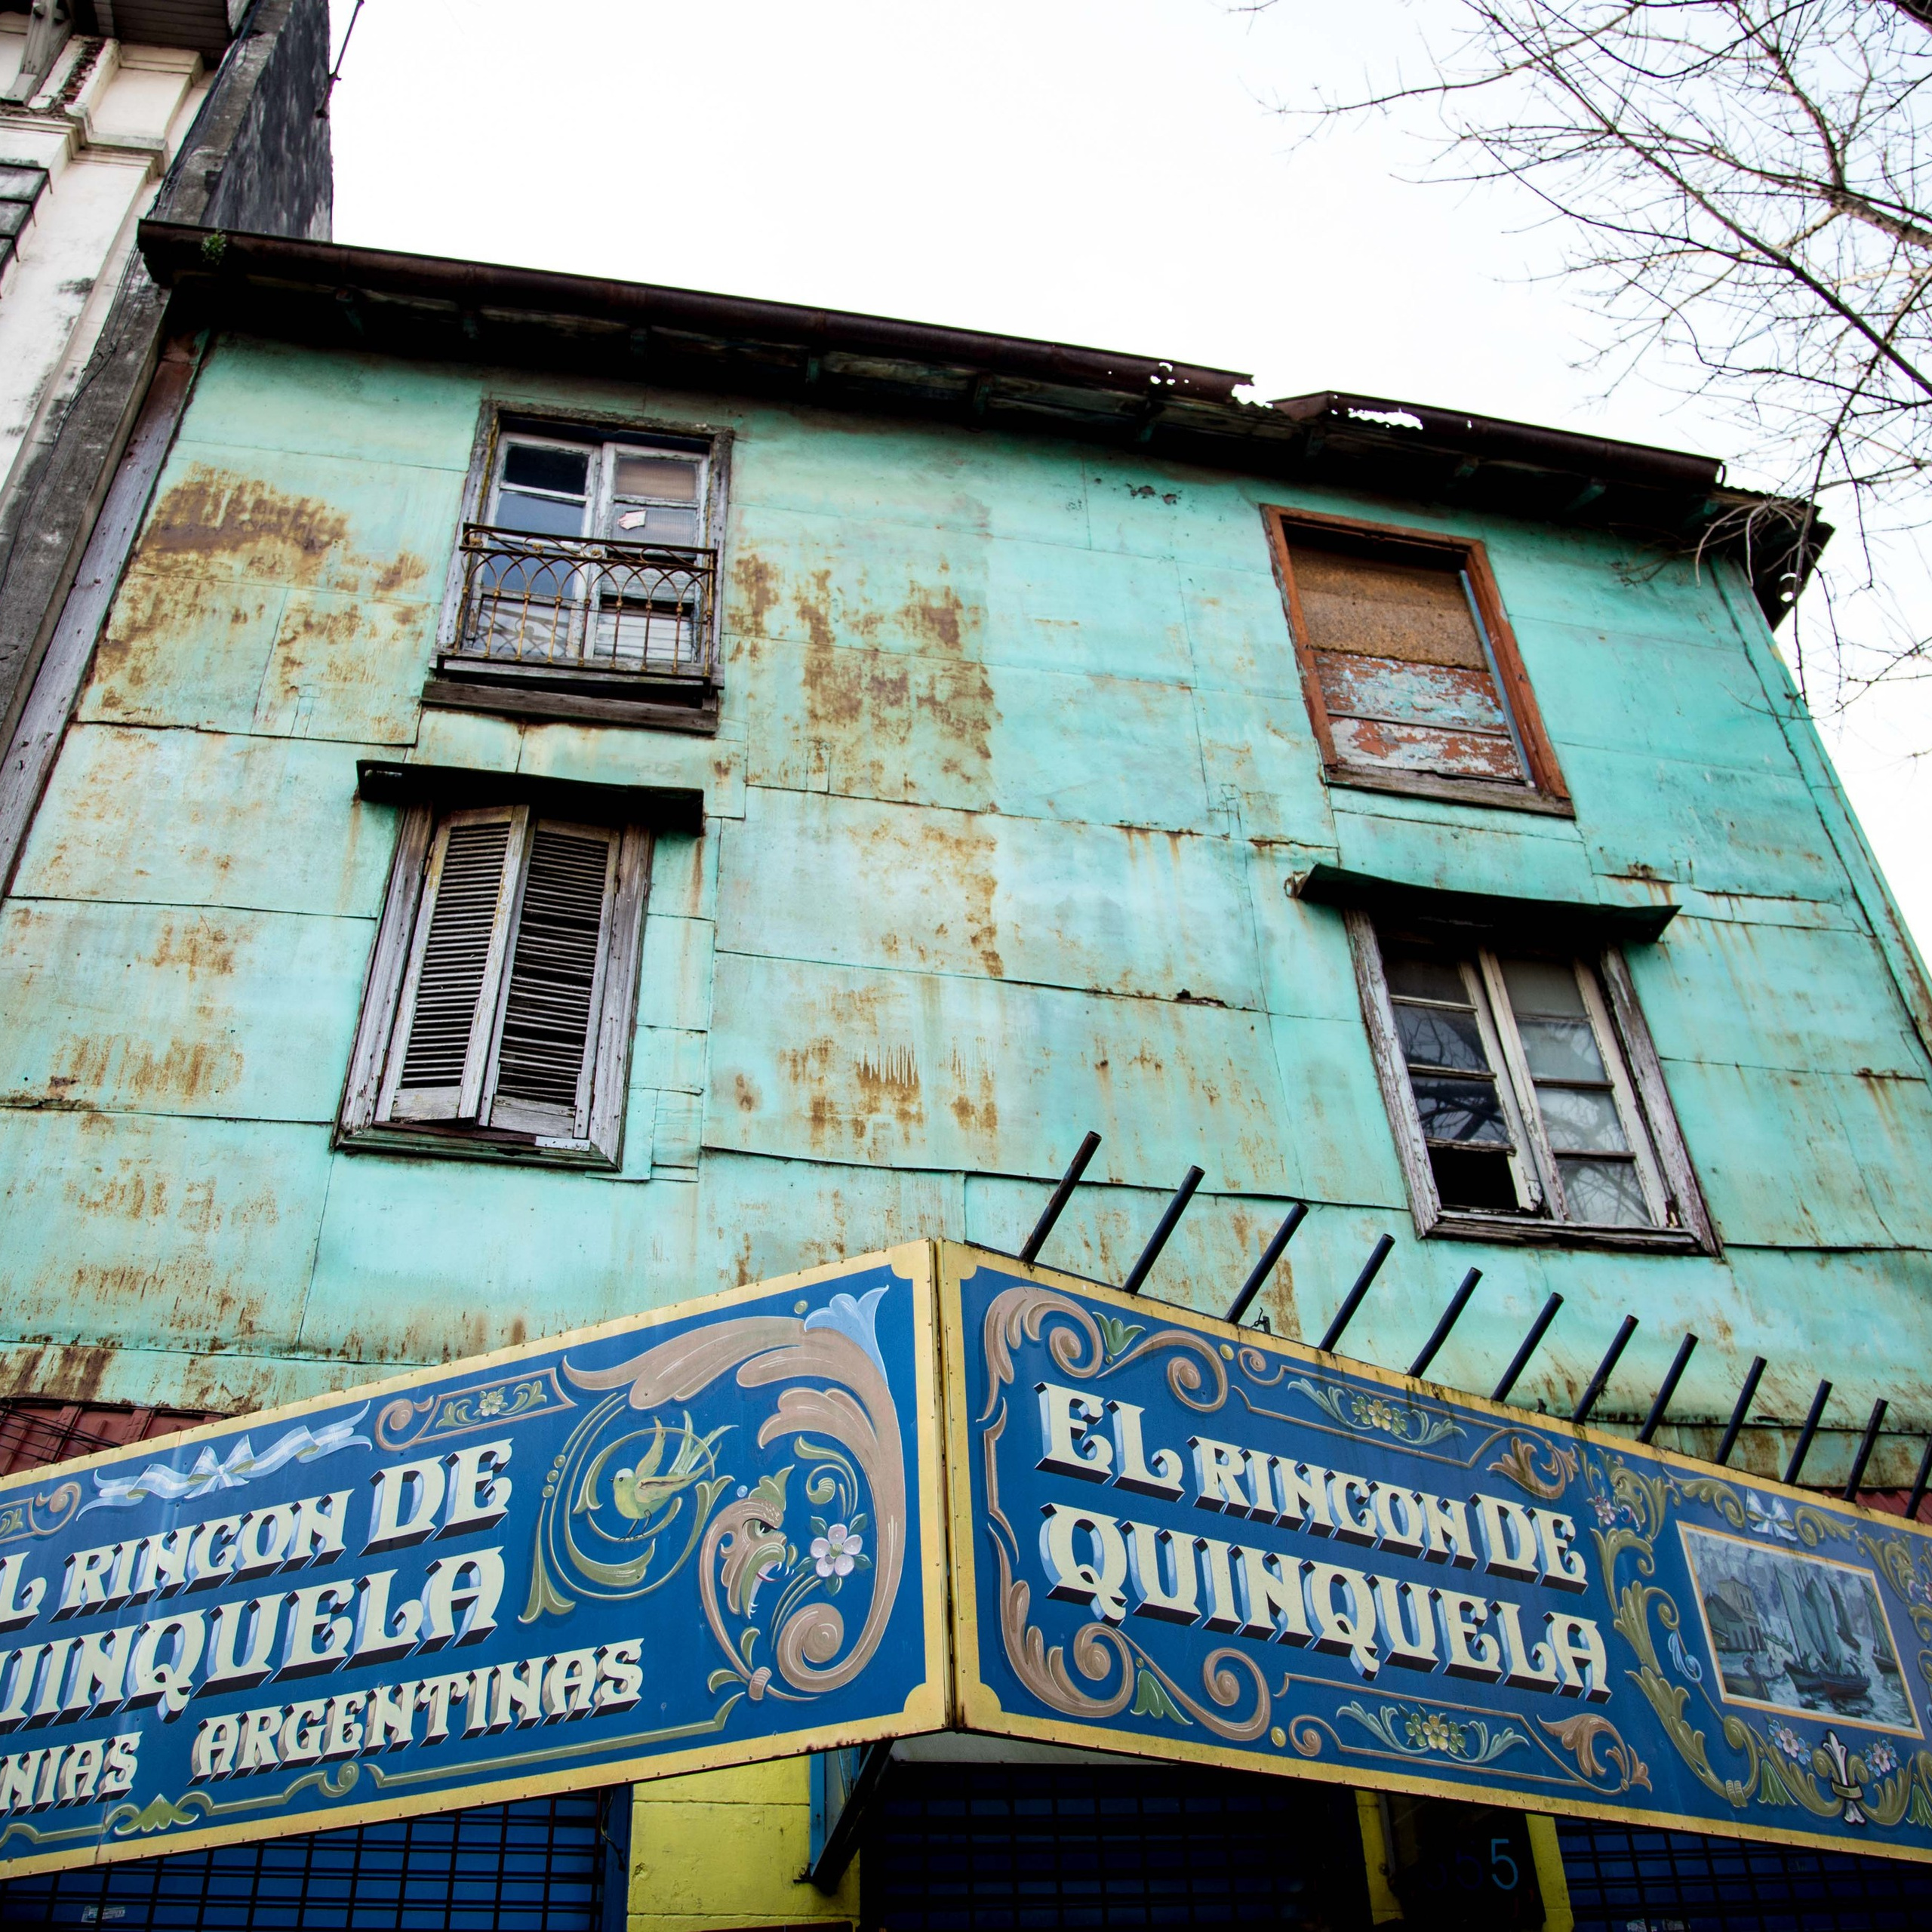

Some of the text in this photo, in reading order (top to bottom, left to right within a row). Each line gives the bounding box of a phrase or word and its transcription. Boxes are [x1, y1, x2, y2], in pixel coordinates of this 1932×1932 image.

[49, 1488, 355, 1623] RINCON
[360, 1438, 514, 1556] DE
[1035, 1381, 1589, 1594] EL RINCON DE
[1038, 1503, 1614, 1704] QUINQUELA
[188, 1638, 645, 1786] ARGENTINAS
